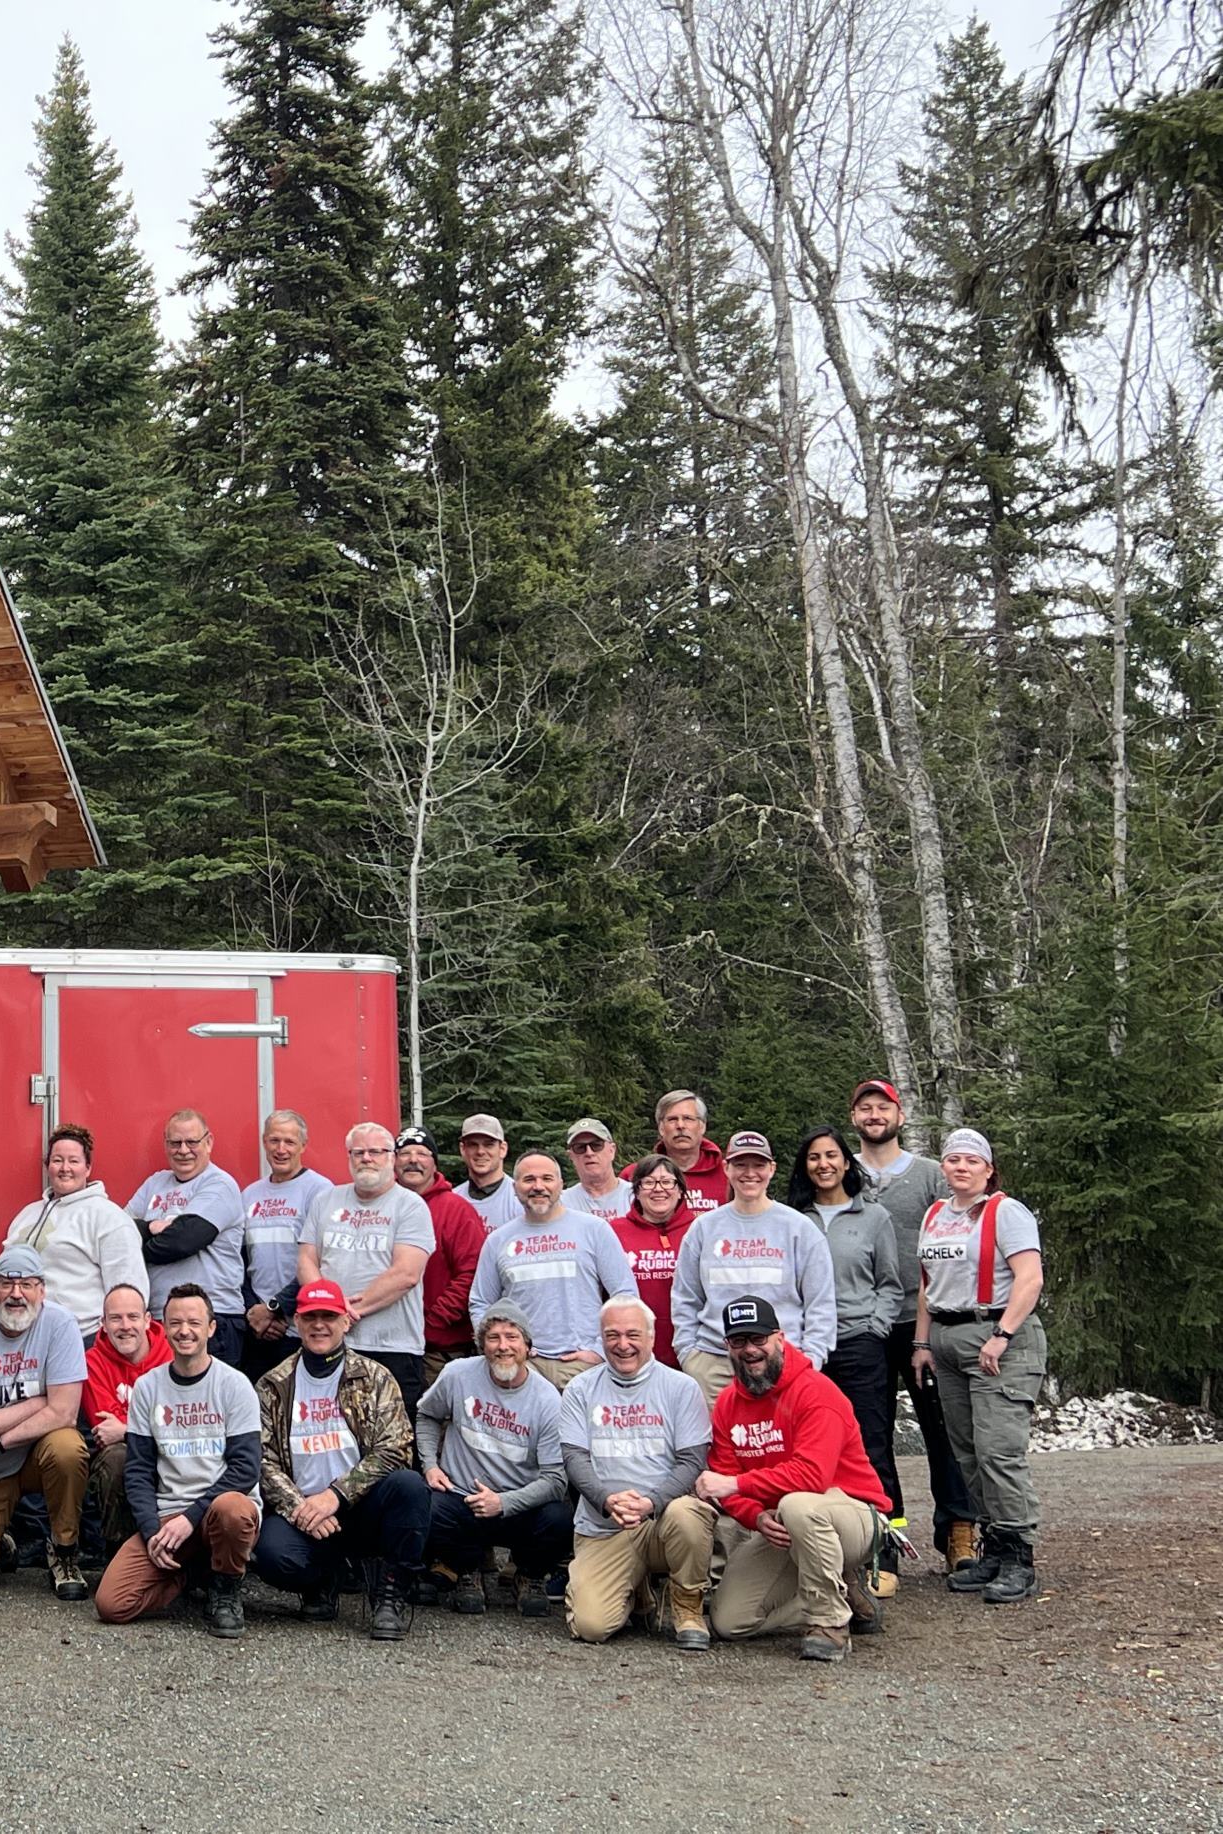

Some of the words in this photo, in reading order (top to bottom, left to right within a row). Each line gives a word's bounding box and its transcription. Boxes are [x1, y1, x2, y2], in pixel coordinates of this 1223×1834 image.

[683, 1189, 703, 1200] AM
[263, 1199, 287, 1208] TEAM
[260, 1208, 297, 1221] RUBICON
[591, 1209, 618, 1219] TEAM
[525, 1235, 559, 1246] TEAM
[735, 1238, 767, 1249] TEAM
[525, 1242, 576, 1256] RUBICON
[639, 1250, 675, 1260] TEAM
[732, 1248, 784, 1259] RUBICON
[920, 1247, 955, 1260] ACHEL
[638, 1259, 678, 1272] RUBIC
[634, 1272, 652, 1280] STER
[175, 1402, 209, 1414] TEAM
[486, 1402, 516, 1421] TEAM
[613, 1404, 646, 1416] TEAM
[175, 1413, 224, 1429] RUBICON
[482, 1413, 530, 1436] RUBICON
[613, 1415, 664, 1430] RUBICON
[160, 1438, 223, 1456] JONATHAN
[302, 1433, 341, 1453] KEVIN
